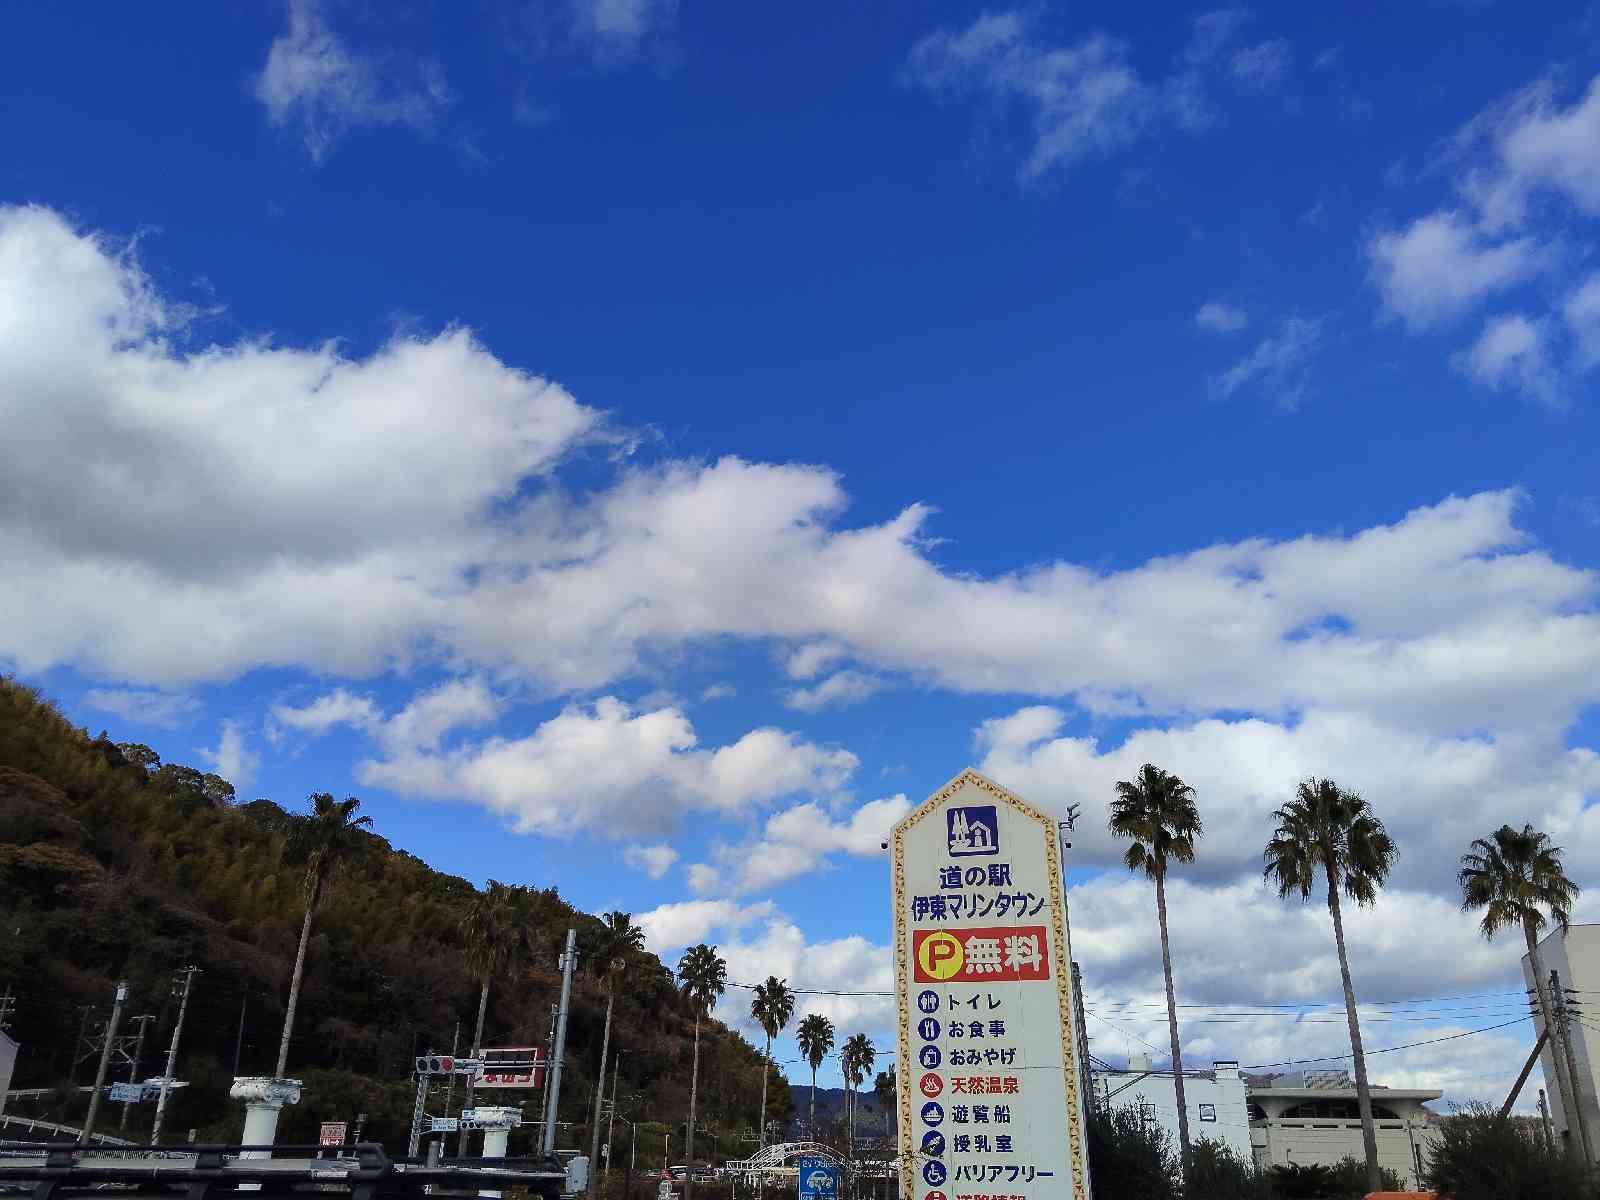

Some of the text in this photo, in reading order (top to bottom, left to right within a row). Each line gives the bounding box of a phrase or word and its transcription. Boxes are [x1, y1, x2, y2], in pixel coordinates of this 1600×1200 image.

[939, 863, 1013, 890] 道の駅
[911, 891, 1045, 922] 伊東マリンタウン
[928, 934, 1043, 974] P 無料
[949, 993, 1002, 1011] トイレ
[948, 1020, 1006, 1038] お食事
[949, 1047, 1016, 1066] おみやげ
[950, 1076, 1020, 1095] 天然温泉
[951, 1104, 1011, 1124] 遊覧船
[953, 1134, 1014, 1153] 授乳室
[954, 1164, 1055, 1183] バリアフリー
